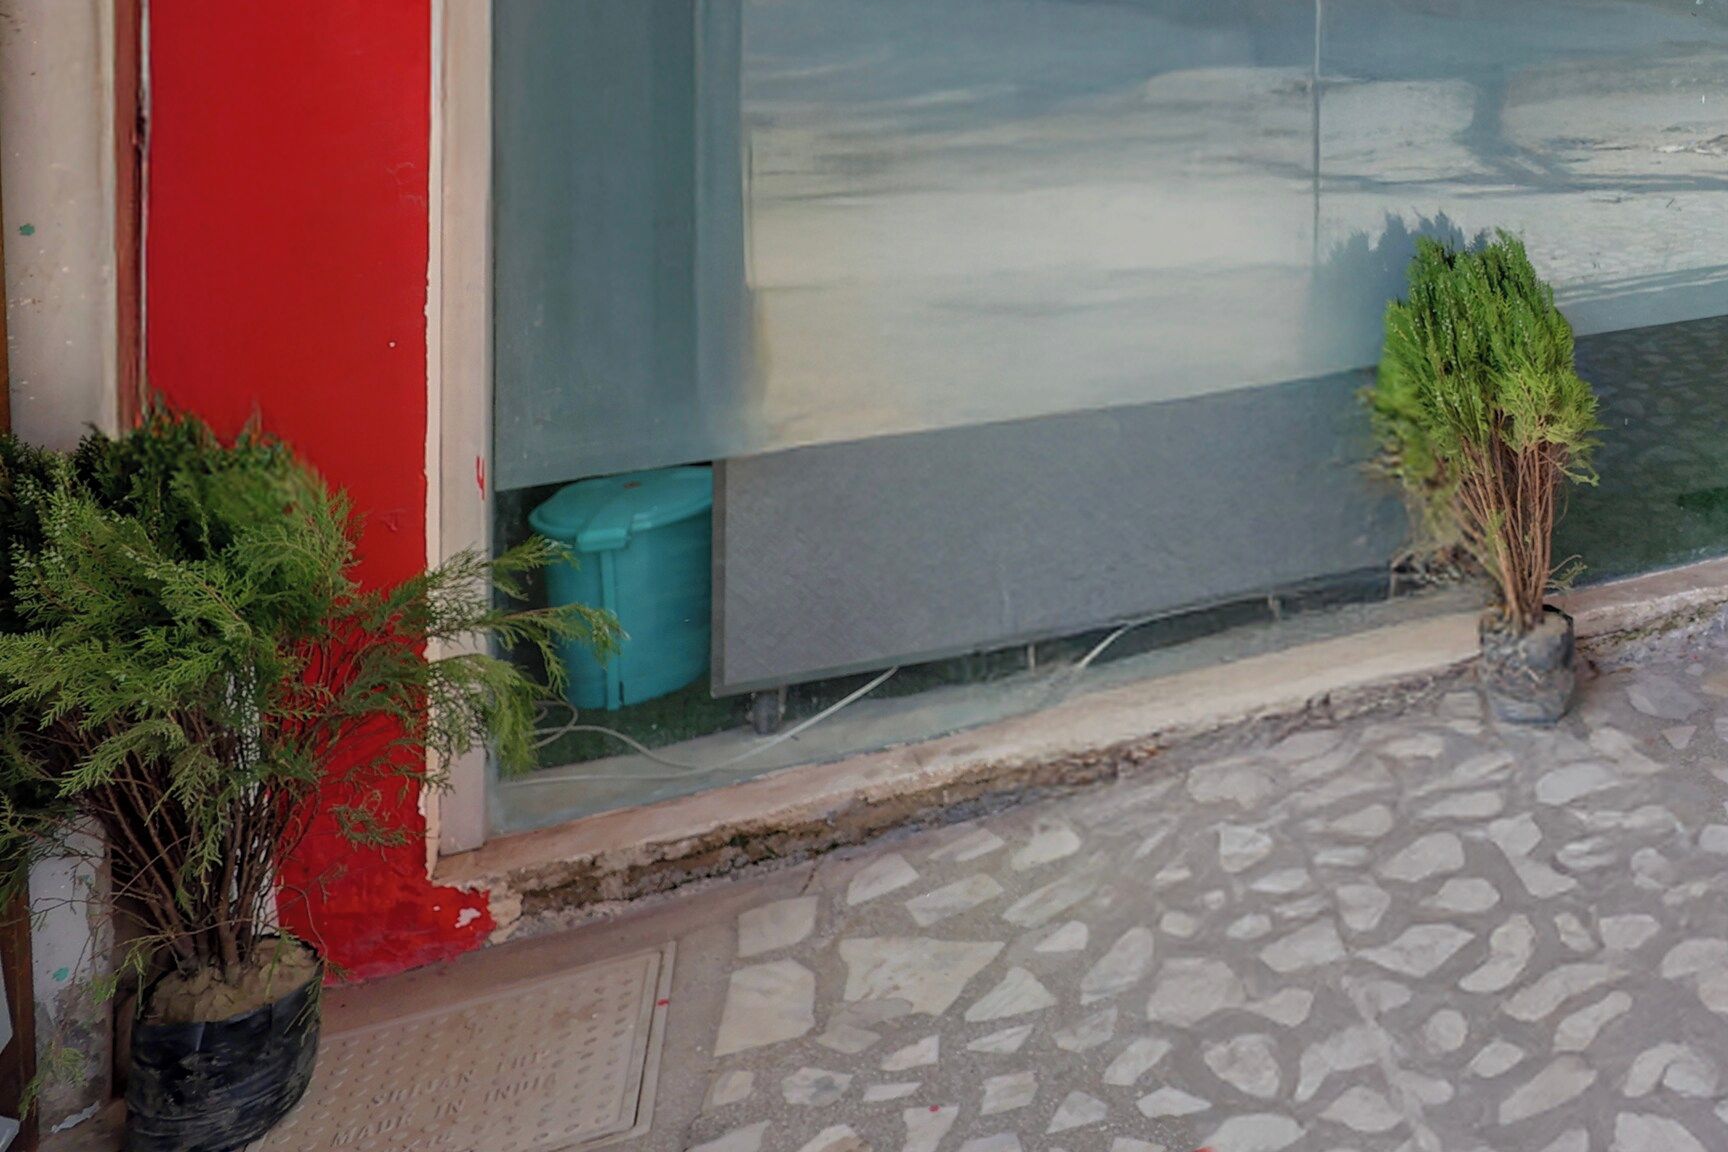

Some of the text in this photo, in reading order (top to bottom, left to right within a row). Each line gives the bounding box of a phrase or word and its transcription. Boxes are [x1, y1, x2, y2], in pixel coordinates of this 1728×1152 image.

[330, 1112, 416, 1148] MADE
[434, 1096, 465, 1119] IN
[482, 1071, 557, 1105] INDIA
